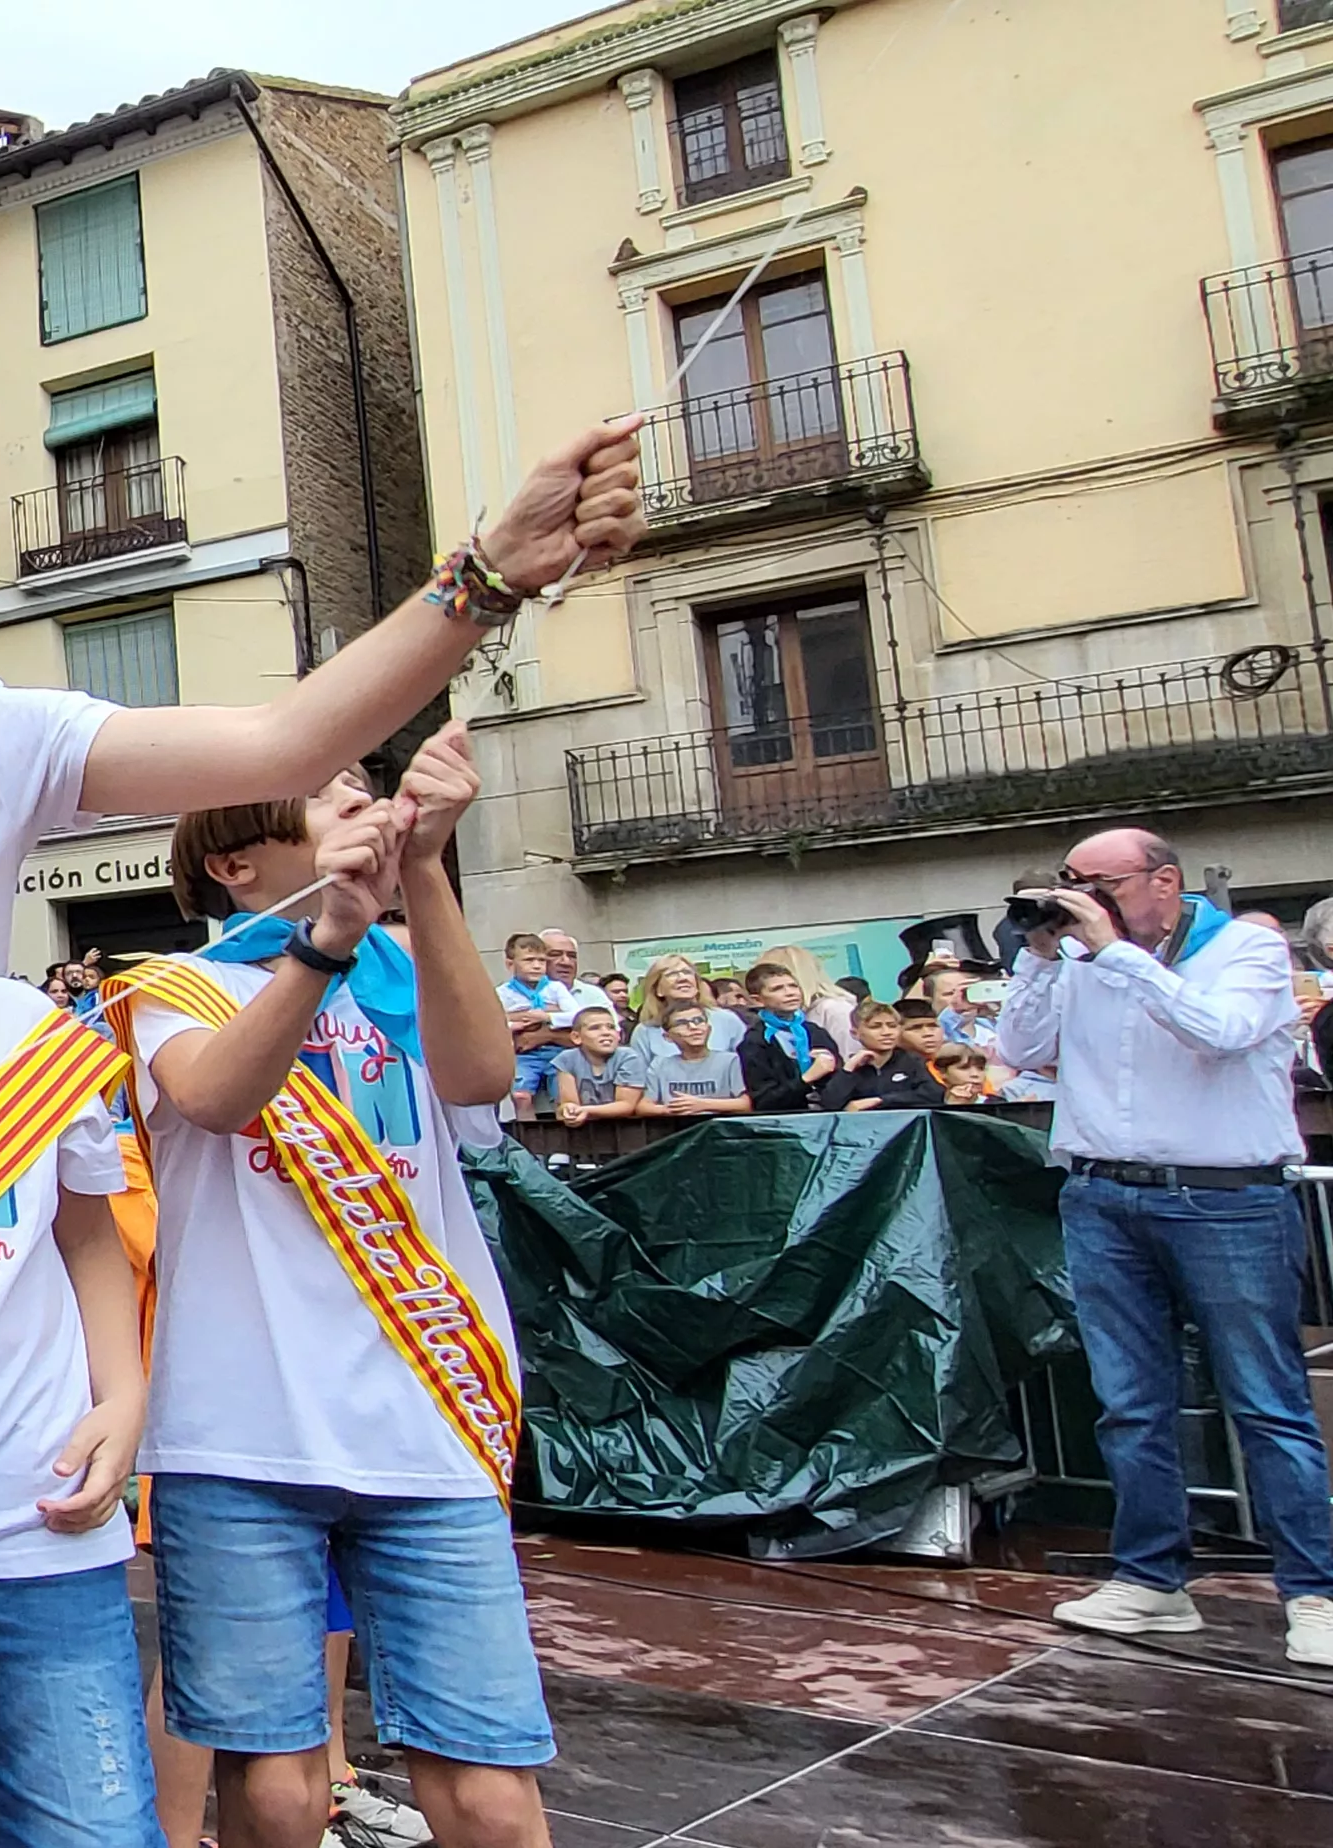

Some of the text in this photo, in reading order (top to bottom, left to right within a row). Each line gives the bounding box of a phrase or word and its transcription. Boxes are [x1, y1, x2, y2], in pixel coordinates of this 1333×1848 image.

[16, 867, 82, 894] ción
[273, 1067, 514, 1485] agalete Monzón
